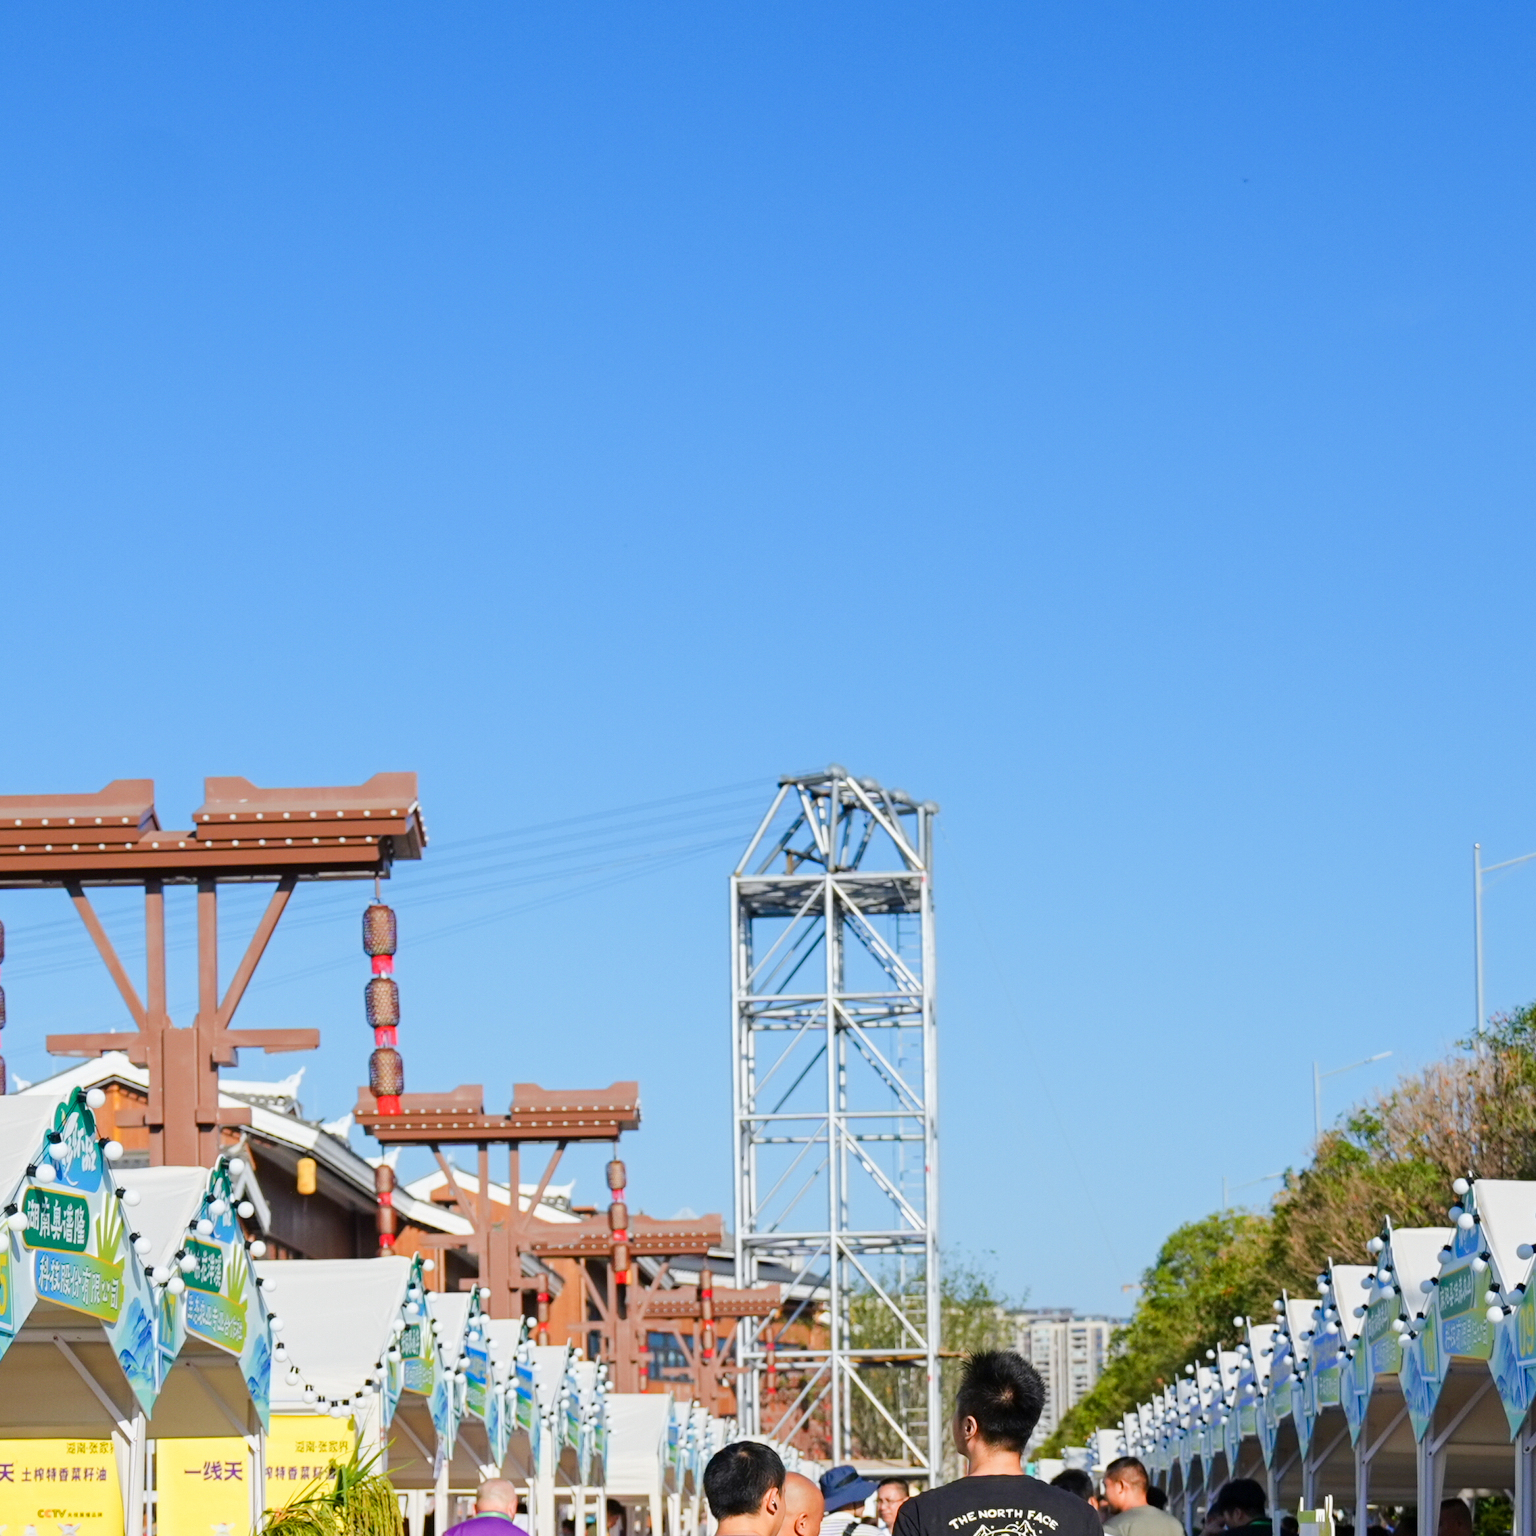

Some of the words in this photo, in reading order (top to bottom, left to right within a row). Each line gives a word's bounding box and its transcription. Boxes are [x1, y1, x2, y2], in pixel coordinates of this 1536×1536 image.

[21, 1467, 107, 1482] 土榨特香菜籽油
[184, 1461, 243, 1481] 一线天
[949, 1511, 977, 1529] THE
[978, 1508, 1023, 1519] NORTH
[1027, 1510, 1059, 1530] FACE
